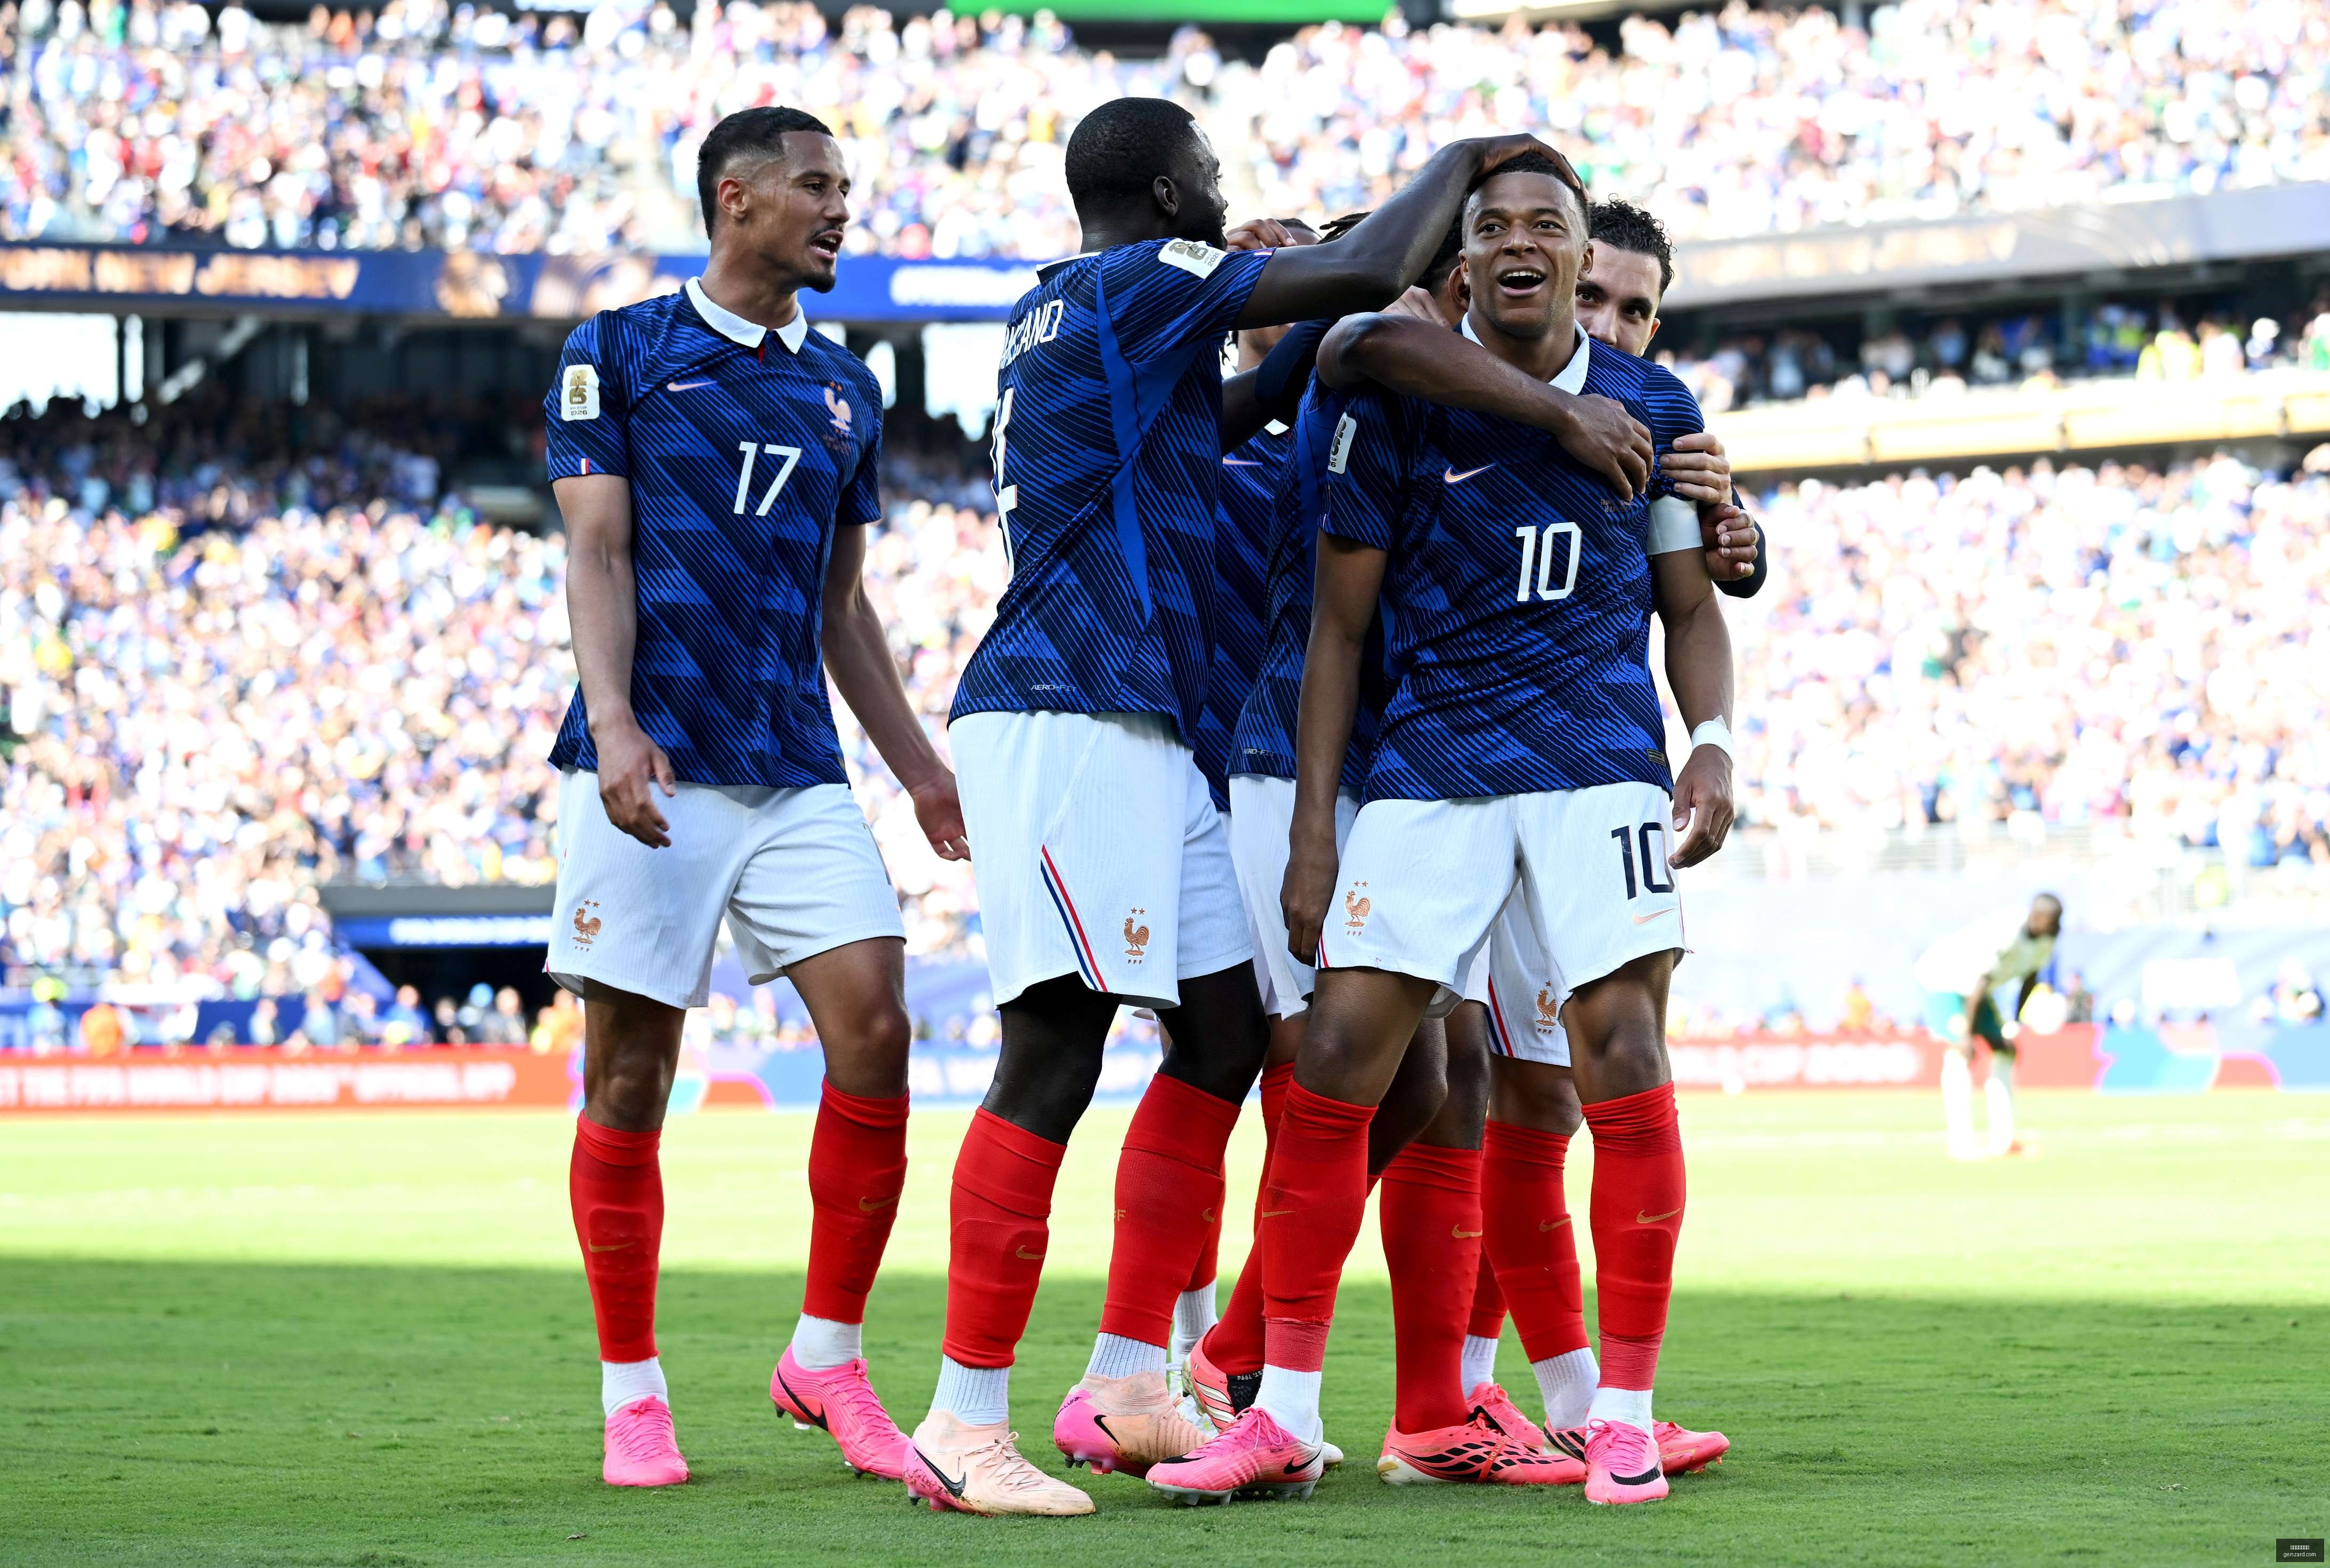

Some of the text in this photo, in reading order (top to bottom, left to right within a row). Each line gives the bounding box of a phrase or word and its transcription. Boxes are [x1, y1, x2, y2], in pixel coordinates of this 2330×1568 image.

[1207, 252, 1220, 267] 2026
[734, 441, 802, 516] 17
[1516, 522, 1582, 601] 10
[1611, 822, 1675, 900] 10
[1253, 1369, 1263, 1377] ST.
